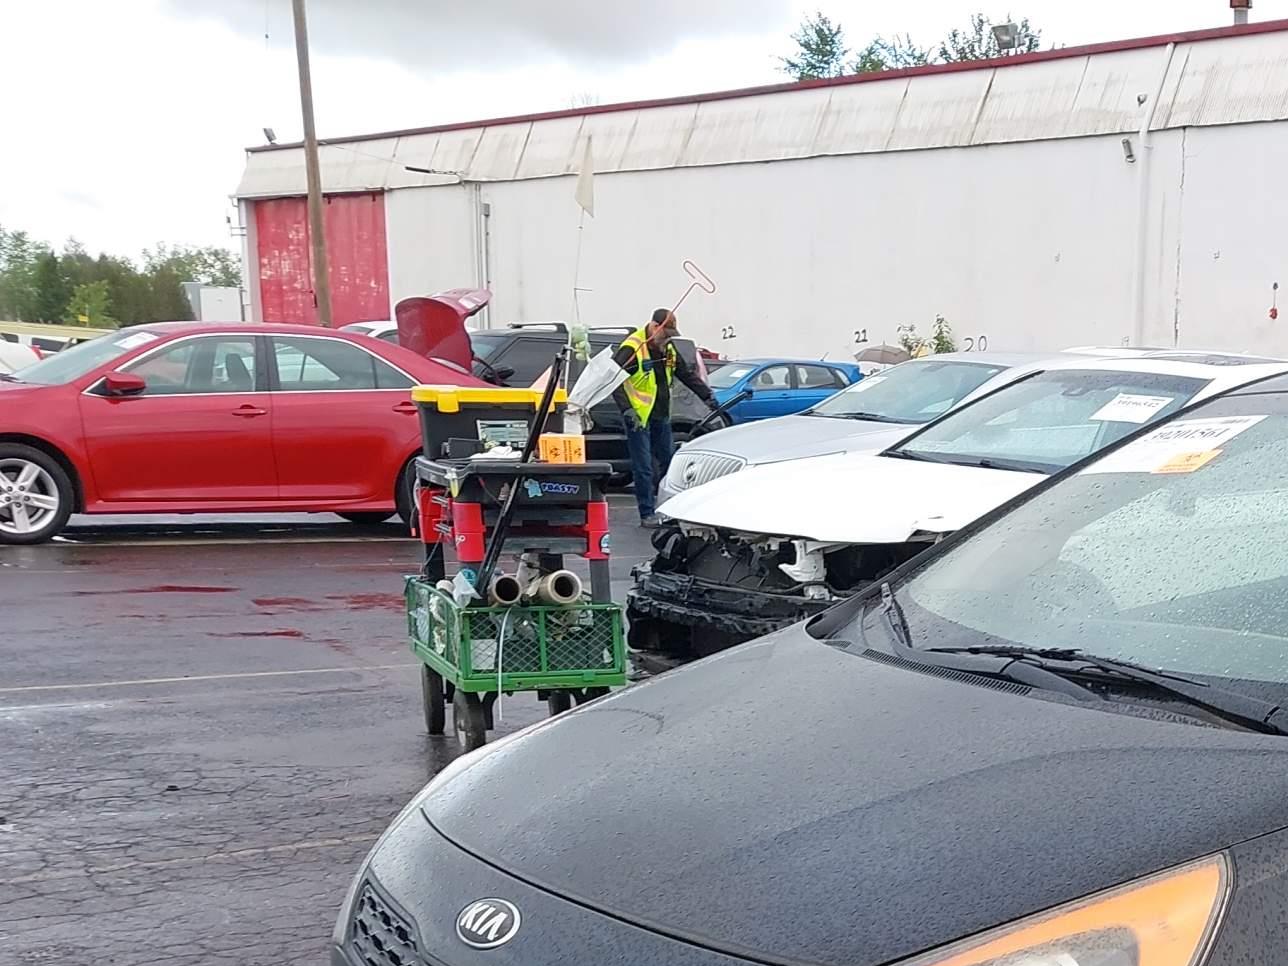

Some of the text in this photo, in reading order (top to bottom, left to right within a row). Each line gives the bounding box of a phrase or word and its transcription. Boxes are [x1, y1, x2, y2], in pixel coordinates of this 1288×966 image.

[721, 325, 737, 340] 22
[854, 328, 869, 344] 21
[963, 335, 988, 352] 20
[460, 903, 509, 942] KIA
